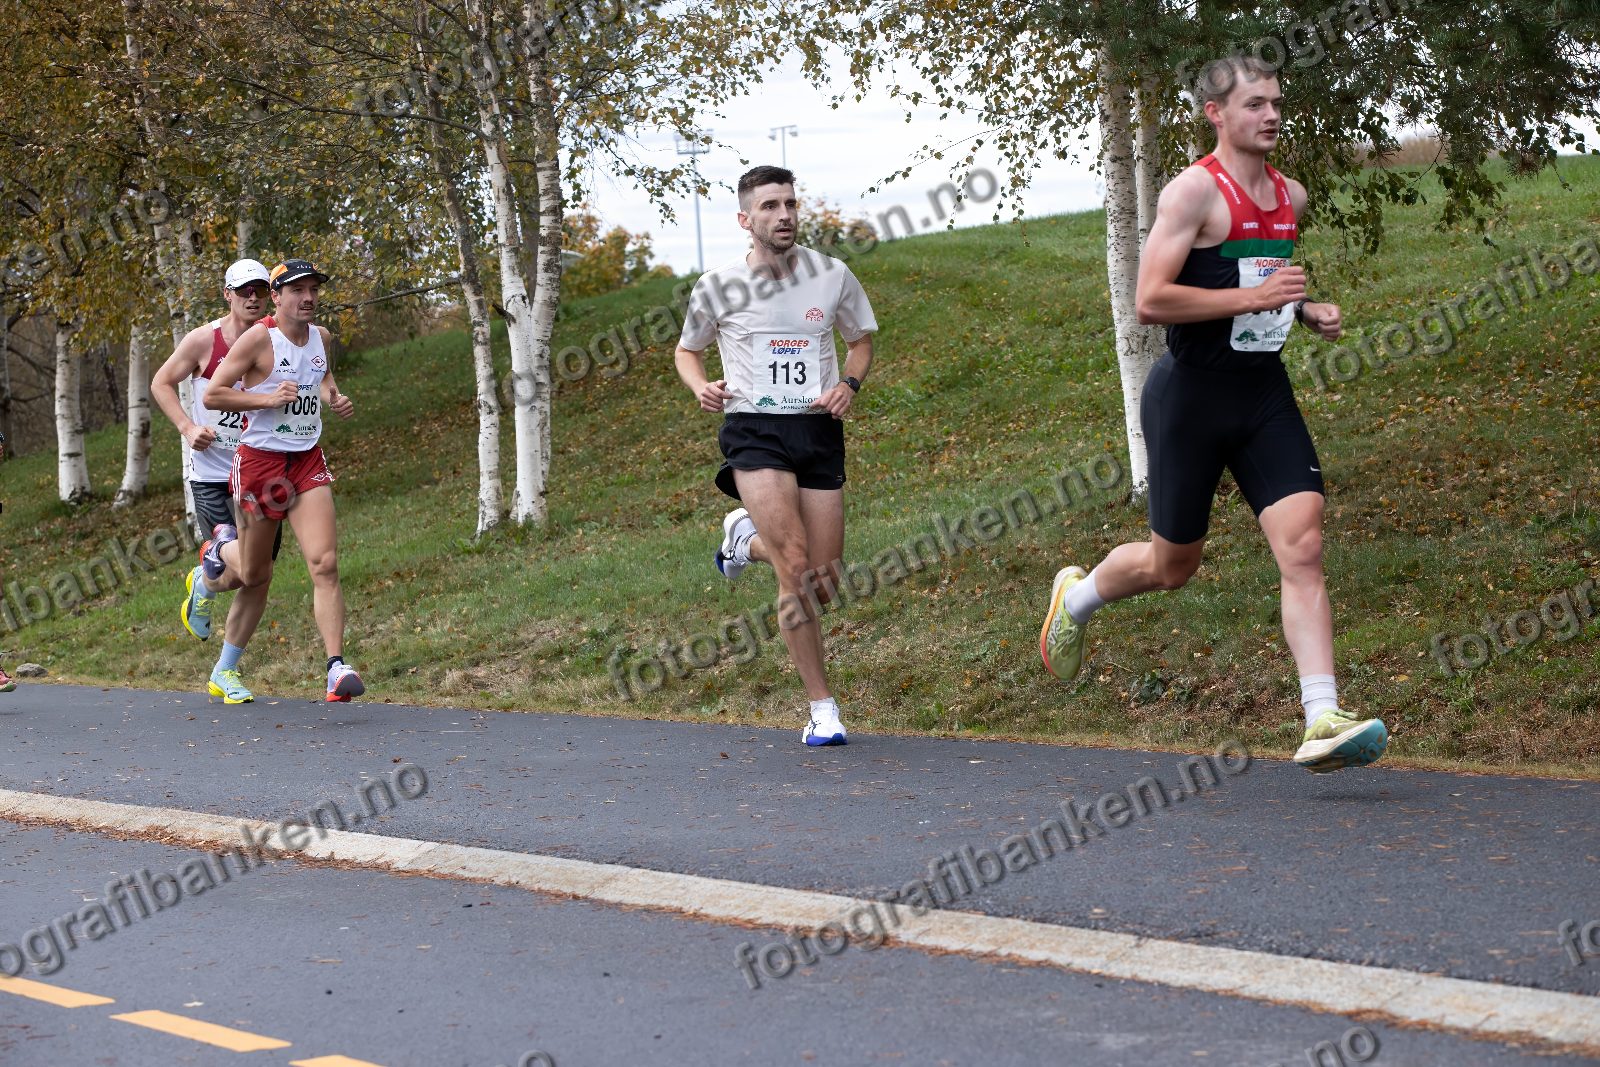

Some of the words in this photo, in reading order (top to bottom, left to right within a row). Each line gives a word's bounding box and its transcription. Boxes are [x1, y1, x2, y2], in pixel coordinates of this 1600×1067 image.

[1254, 259, 1287, 268] NORGES
[769, 339, 809, 347] NORGES
[772, 347, 803, 355] LØPET
[768, 361, 807, 385] 113
[284, 395, 318, 416] 1006
